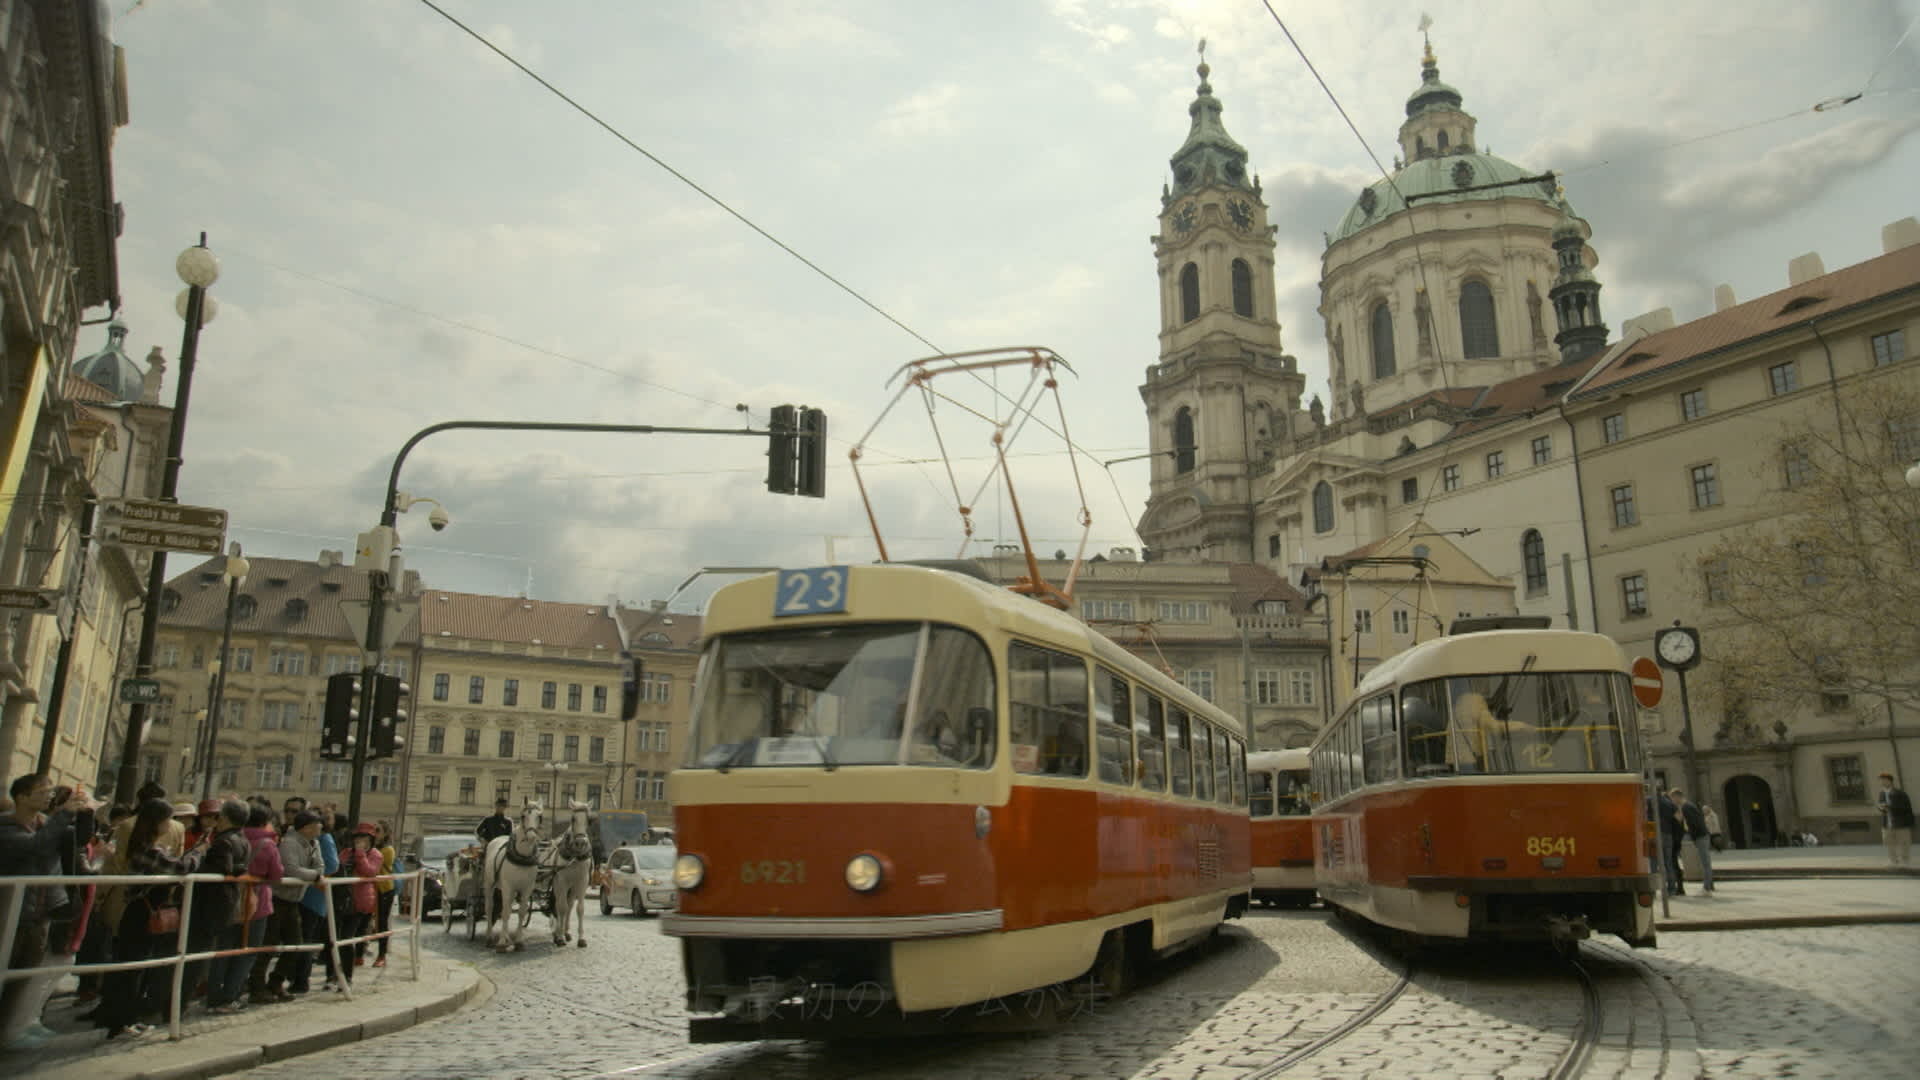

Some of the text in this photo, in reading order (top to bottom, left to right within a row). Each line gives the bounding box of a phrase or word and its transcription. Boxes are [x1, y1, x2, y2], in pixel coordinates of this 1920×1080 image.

[783, 570, 842, 611] 23
[138, 684, 157, 698] WC
[1522, 744, 1553, 768] 12
[1527, 836, 1577, 857] 8541
[740, 858, 809, 885] 6921
